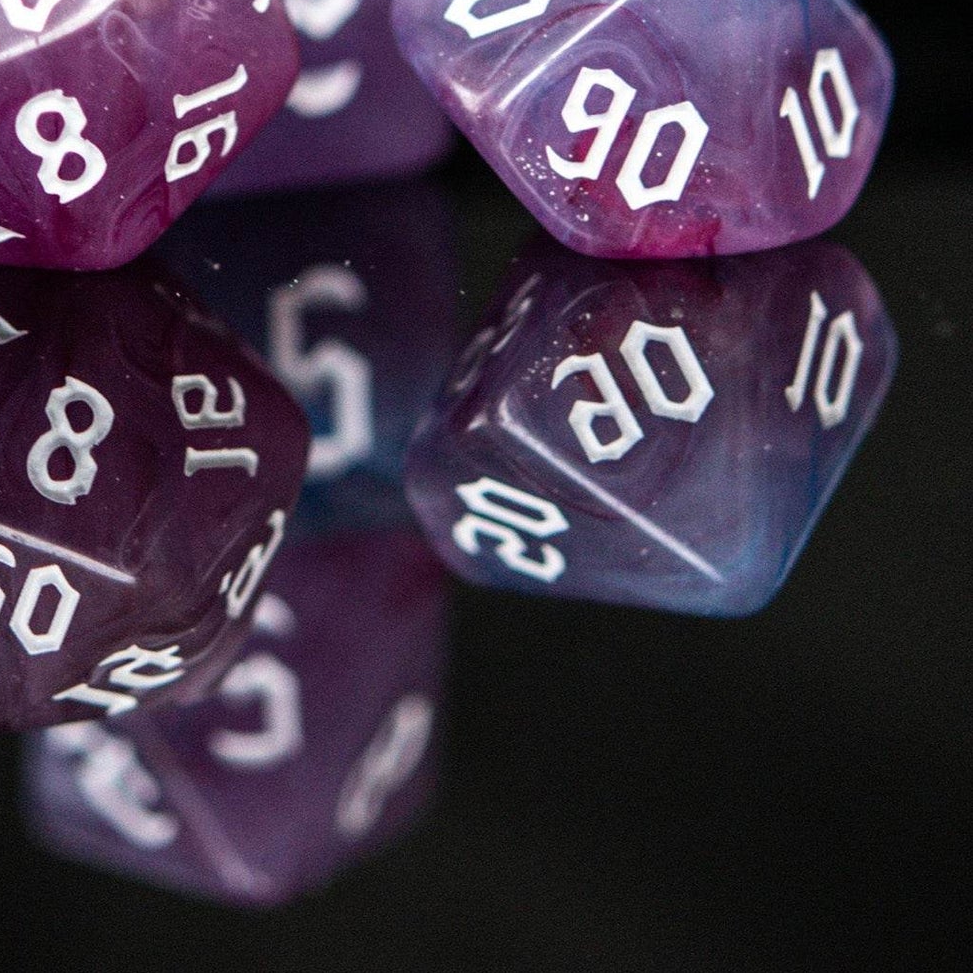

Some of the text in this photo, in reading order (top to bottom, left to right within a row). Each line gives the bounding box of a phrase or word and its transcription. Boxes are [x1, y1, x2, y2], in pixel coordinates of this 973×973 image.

[14, 89, 108, 205] 8
[545, 66, 709, 211] 90
[779, 48, 860, 201] 10
